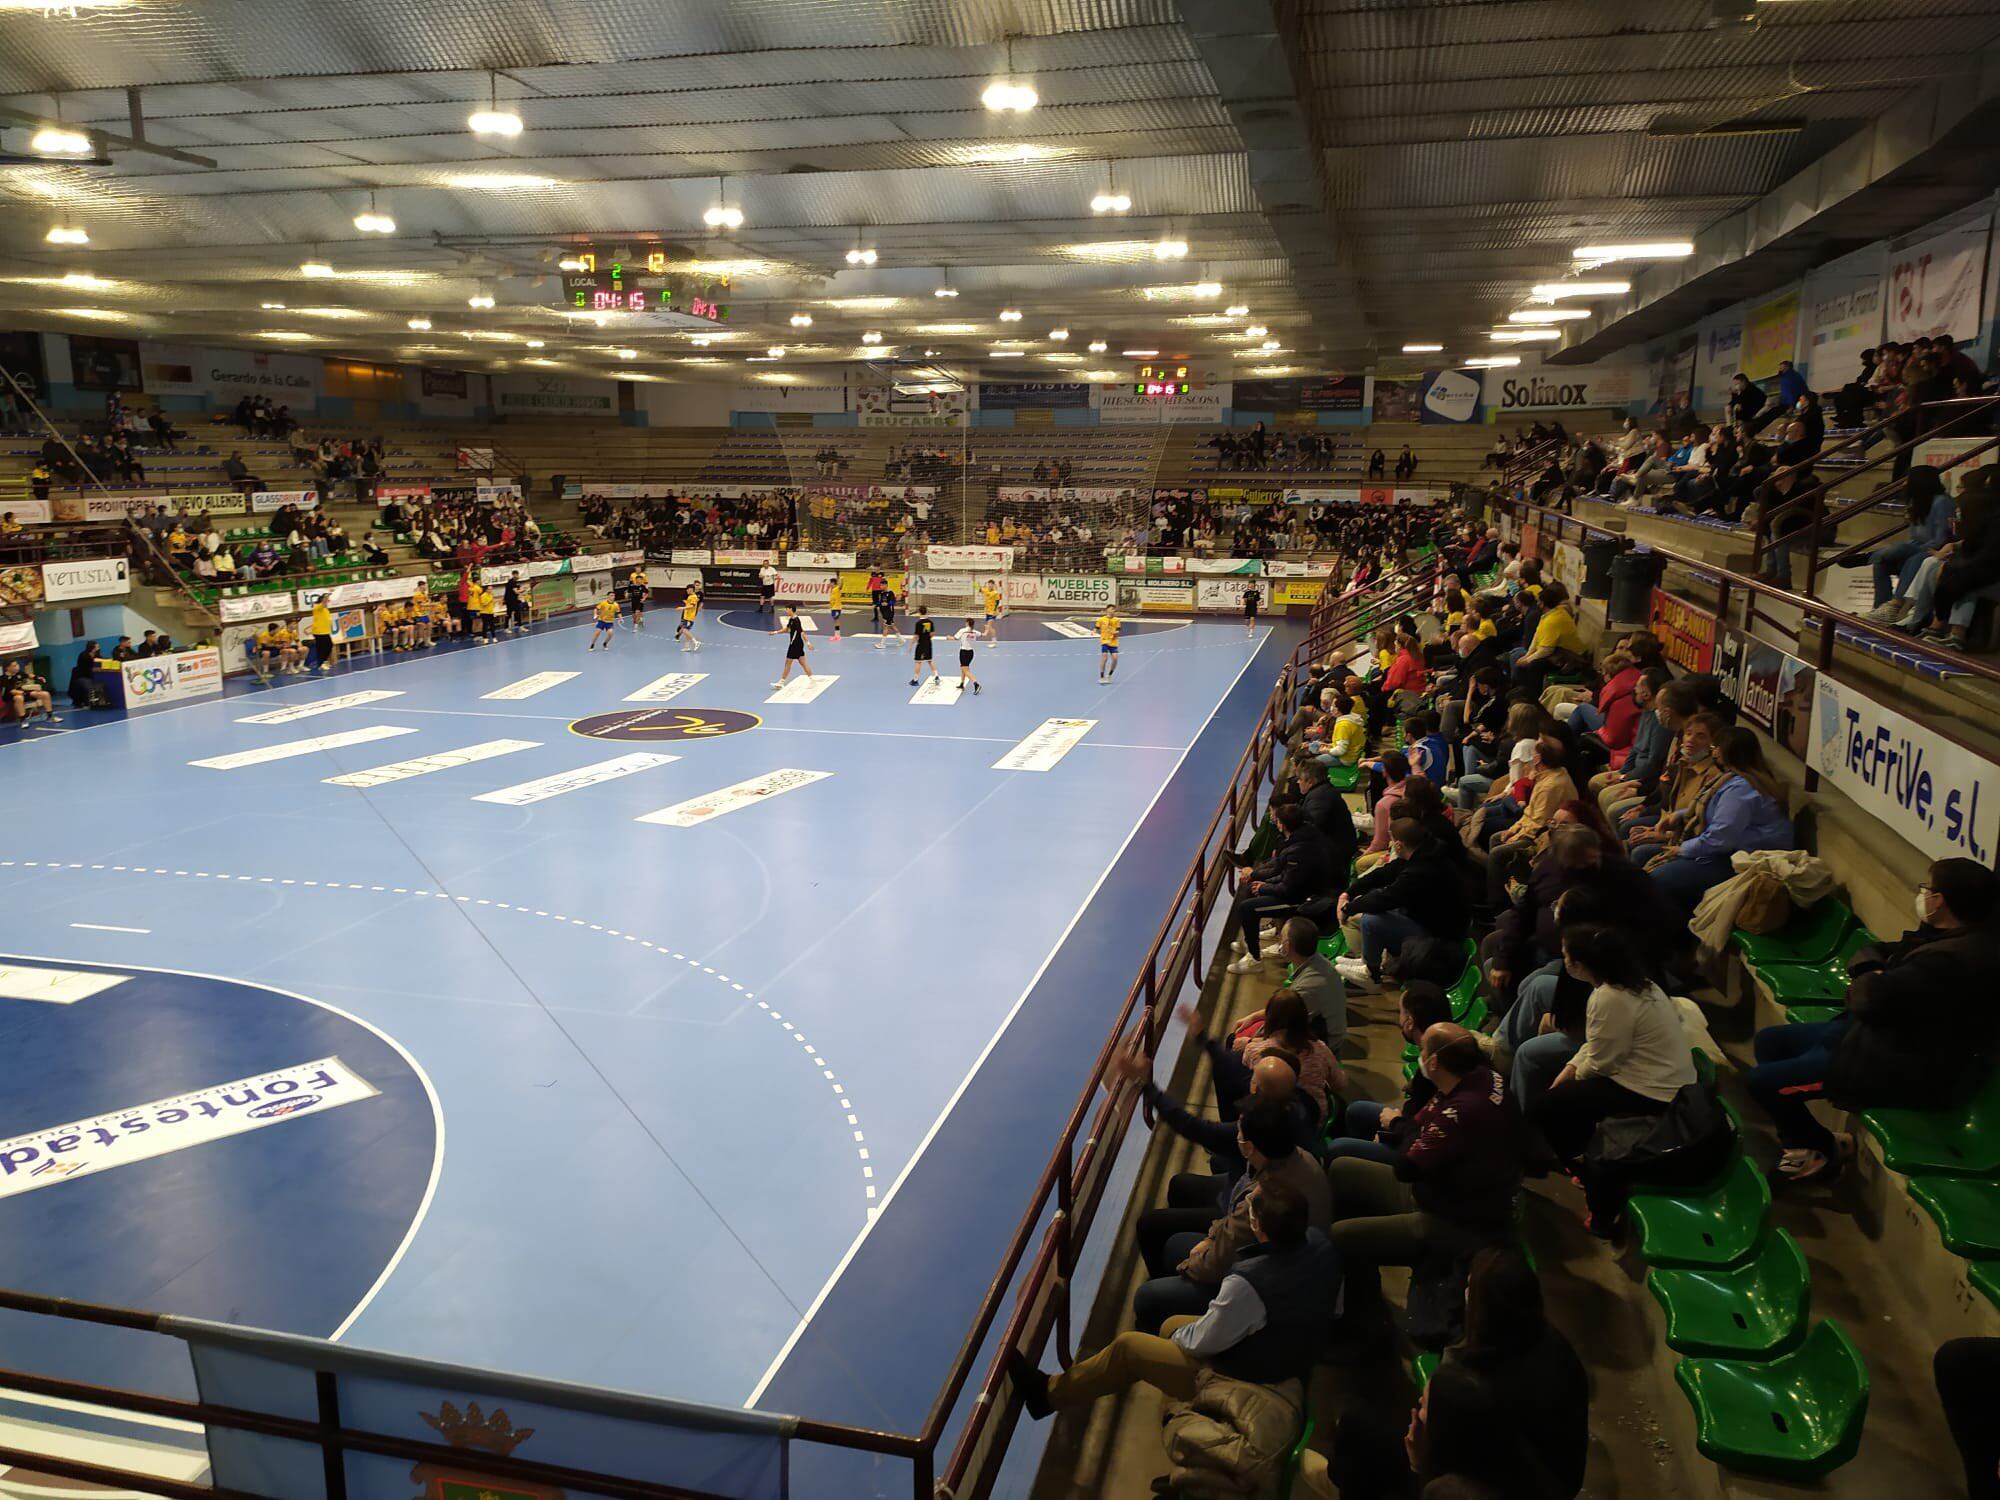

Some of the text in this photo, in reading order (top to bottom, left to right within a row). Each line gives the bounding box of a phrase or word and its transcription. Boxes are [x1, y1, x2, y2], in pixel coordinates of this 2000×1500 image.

[611, 263, 622, 279] 2
[648, 253, 665, 273] 12
[569, 278, 598, 287] LOCAL
[594, 291, 646, 310] 04:15
[210, 368, 312, 388] Gerardo de la Calle
[1502, 377, 1588, 408] Solinox
[171, 495, 244, 510] NUEVO ALLENDE
[1047, 578, 1109, 590] MUEBLES
[1047, 591, 1109, 602] ALBERTO
[1735, 643, 1775, 728] Marina
[1846, 708, 1986, 862] TecFriVe, s.l.
[0, 1070, 339, 1176] Fontestad
